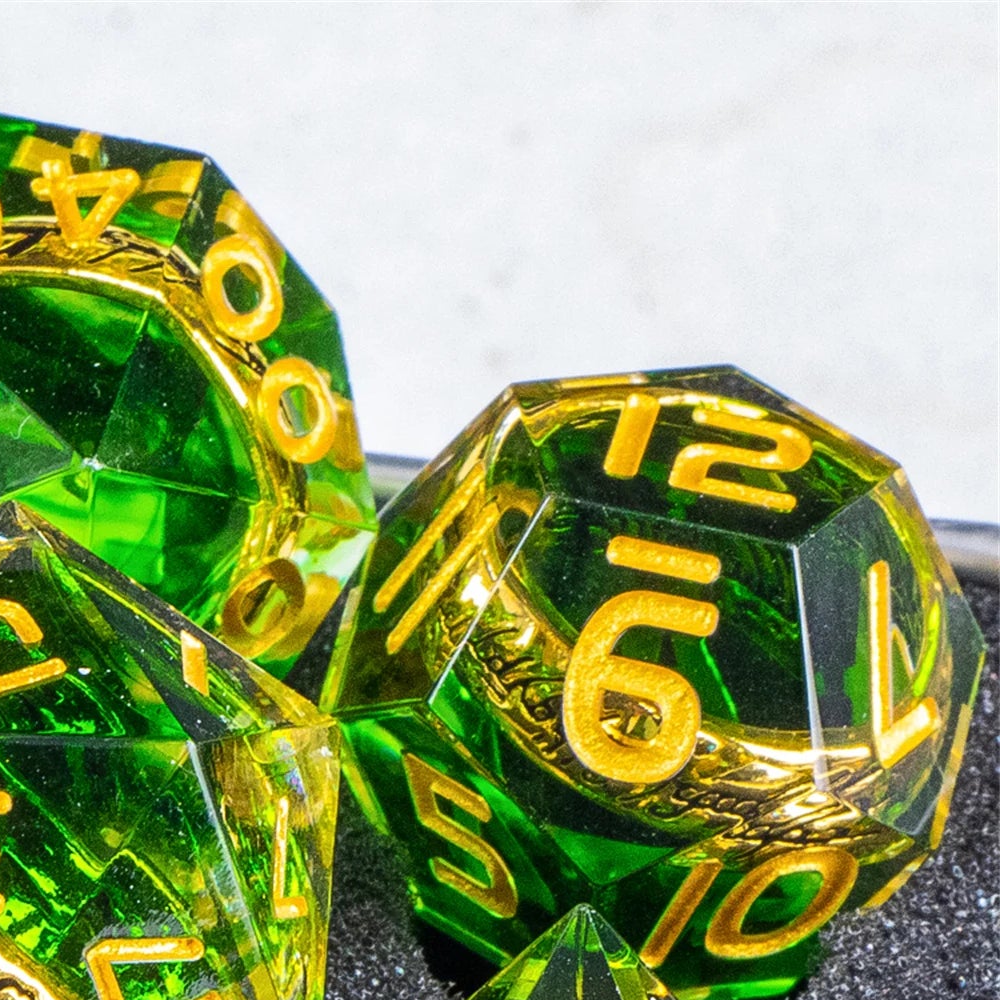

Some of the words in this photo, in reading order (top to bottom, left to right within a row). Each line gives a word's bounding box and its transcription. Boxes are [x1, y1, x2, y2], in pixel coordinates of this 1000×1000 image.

[604, 393, 812, 513] 12
[403, 752, 519, 918] 5
[640, 847, 859, 969] 10
